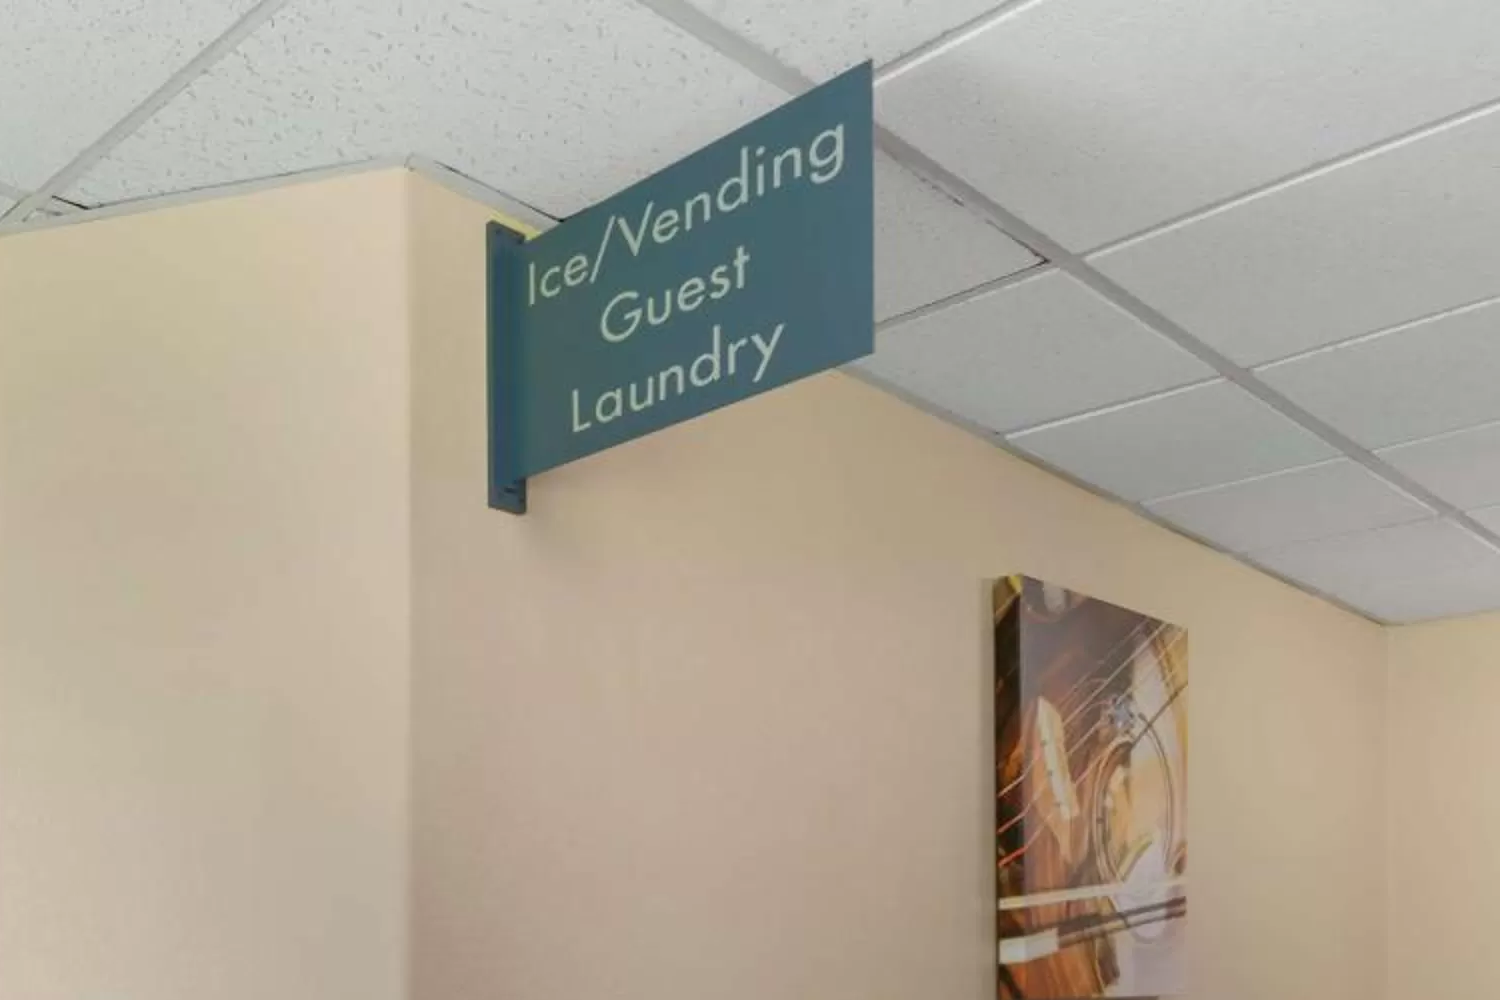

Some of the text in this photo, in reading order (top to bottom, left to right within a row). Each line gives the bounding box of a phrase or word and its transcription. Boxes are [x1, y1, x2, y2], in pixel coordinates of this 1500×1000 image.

[527, 123, 845, 306] Ice/Vending
[600, 245, 750, 342] Guest
[572, 323, 785, 433] Laundry
